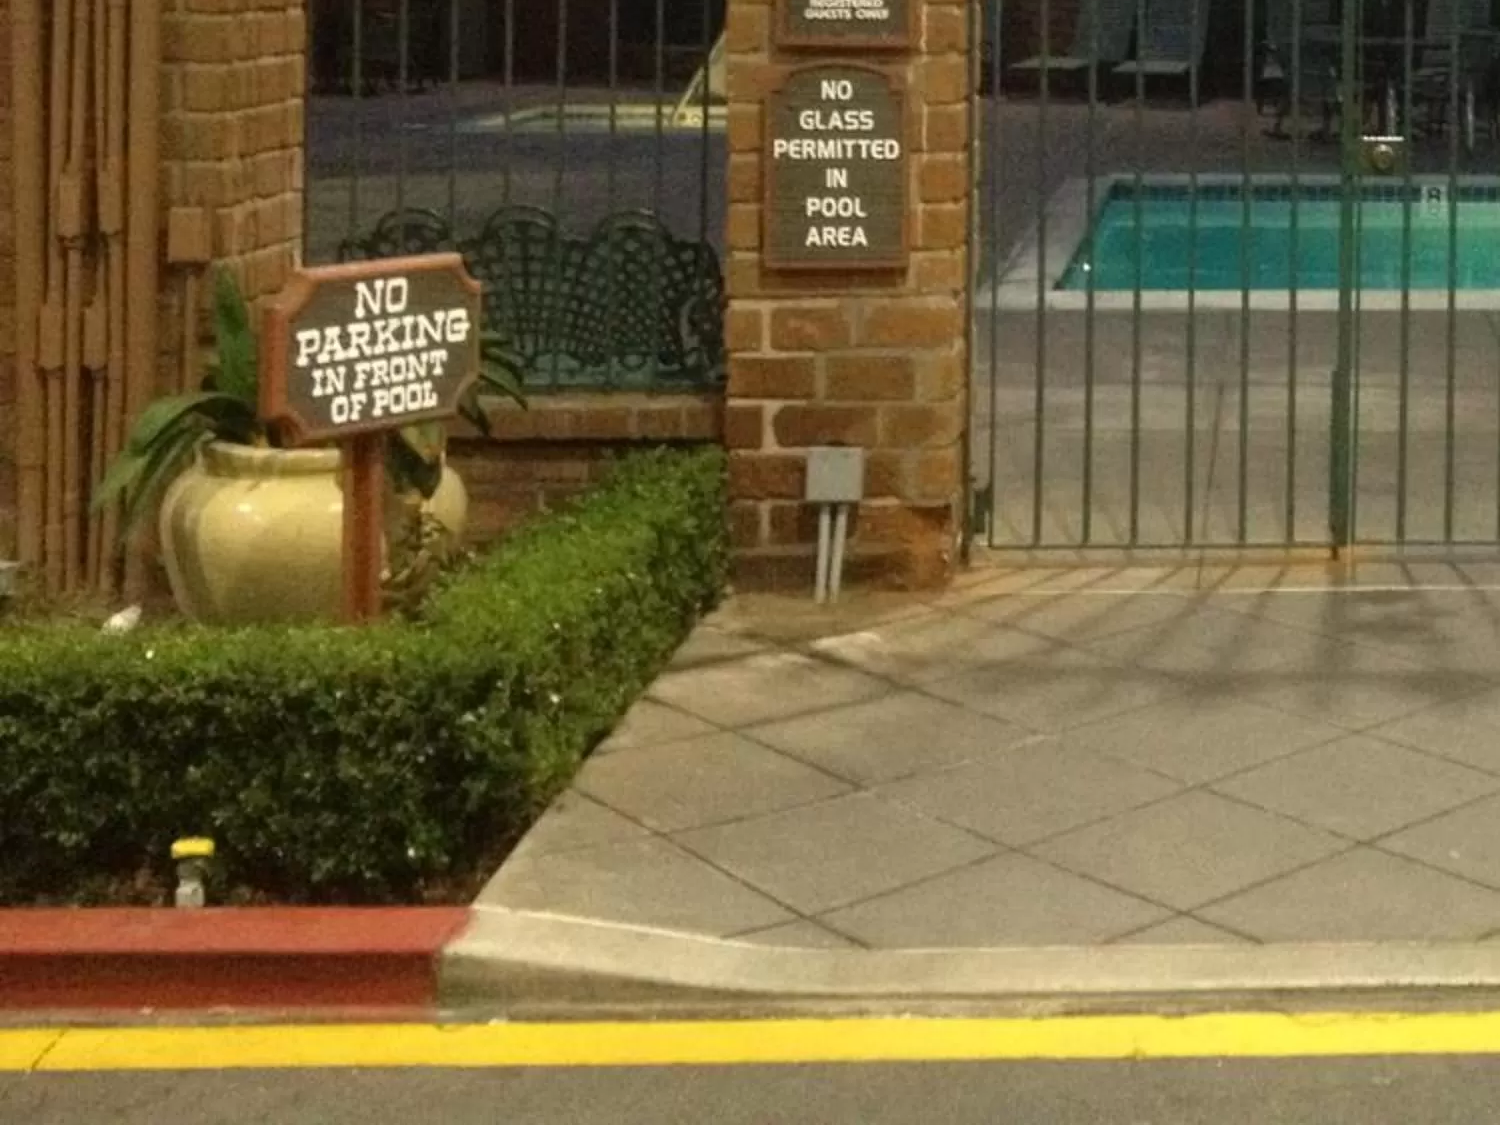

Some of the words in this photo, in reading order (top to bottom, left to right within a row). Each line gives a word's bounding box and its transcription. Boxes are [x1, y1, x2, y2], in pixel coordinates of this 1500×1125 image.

[821, 79, 853, 100] NO
[799, 109, 875, 130] GLASS
[773, 138, 900, 159] PERMITTED
[826, 168, 848, 187] IN
[806, 196, 867, 217] POOL
[805, 226, 868, 246] AREA
[355, 277, 409, 319] NO
[296, 308, 471, 367] PARKING
[312, 366, 346, 397] IN
[353, 349, 448, 389] FRONT
[331, 392, 367, 423] OF
[372, 380, 438, 416] POOL
